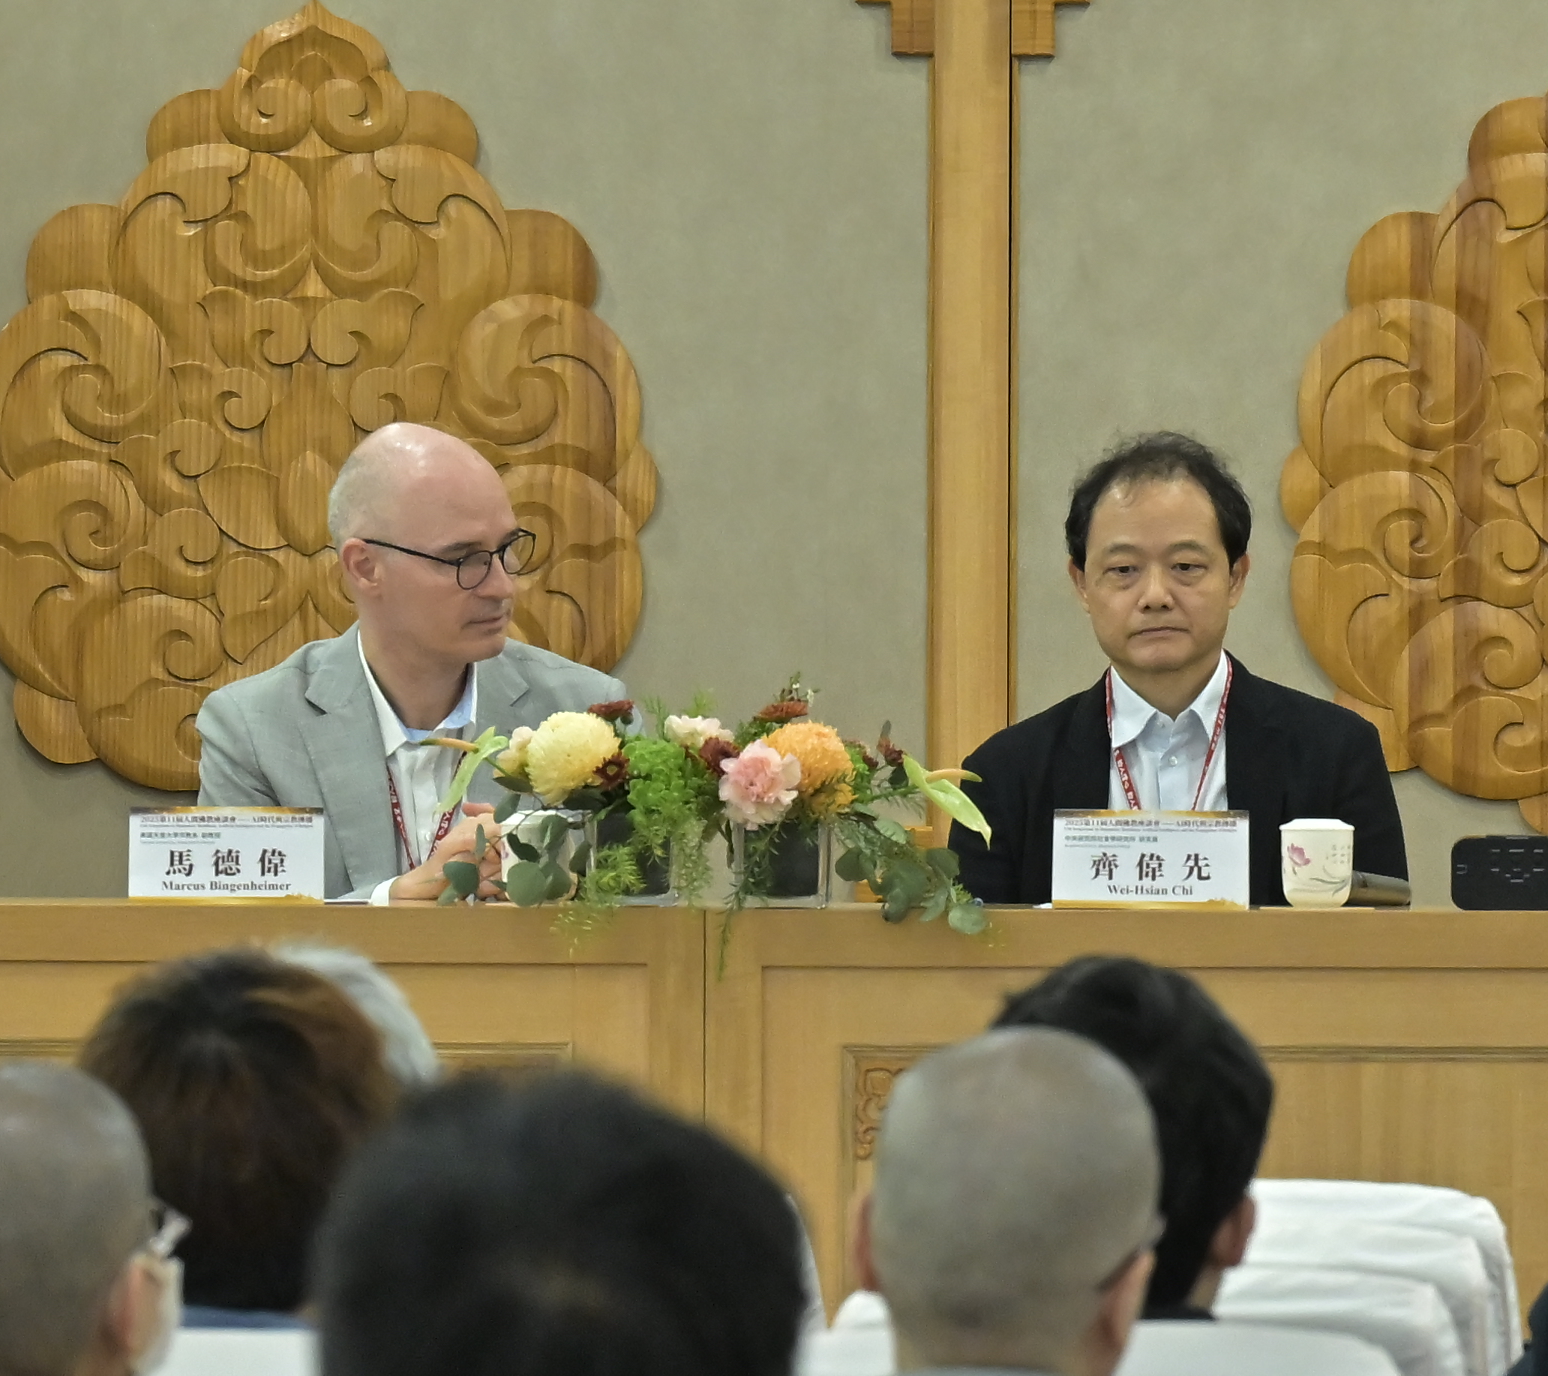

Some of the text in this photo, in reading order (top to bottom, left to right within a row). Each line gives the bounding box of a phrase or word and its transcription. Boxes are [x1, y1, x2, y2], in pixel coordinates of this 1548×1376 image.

[165, 848, 287, 877] 馬德偉
[1091, 852, 1211, 882] 齊偉先
[162, 880, 292, 892] Marcus Bingenheimer
[1171, 885, 1193, 896] Chi
